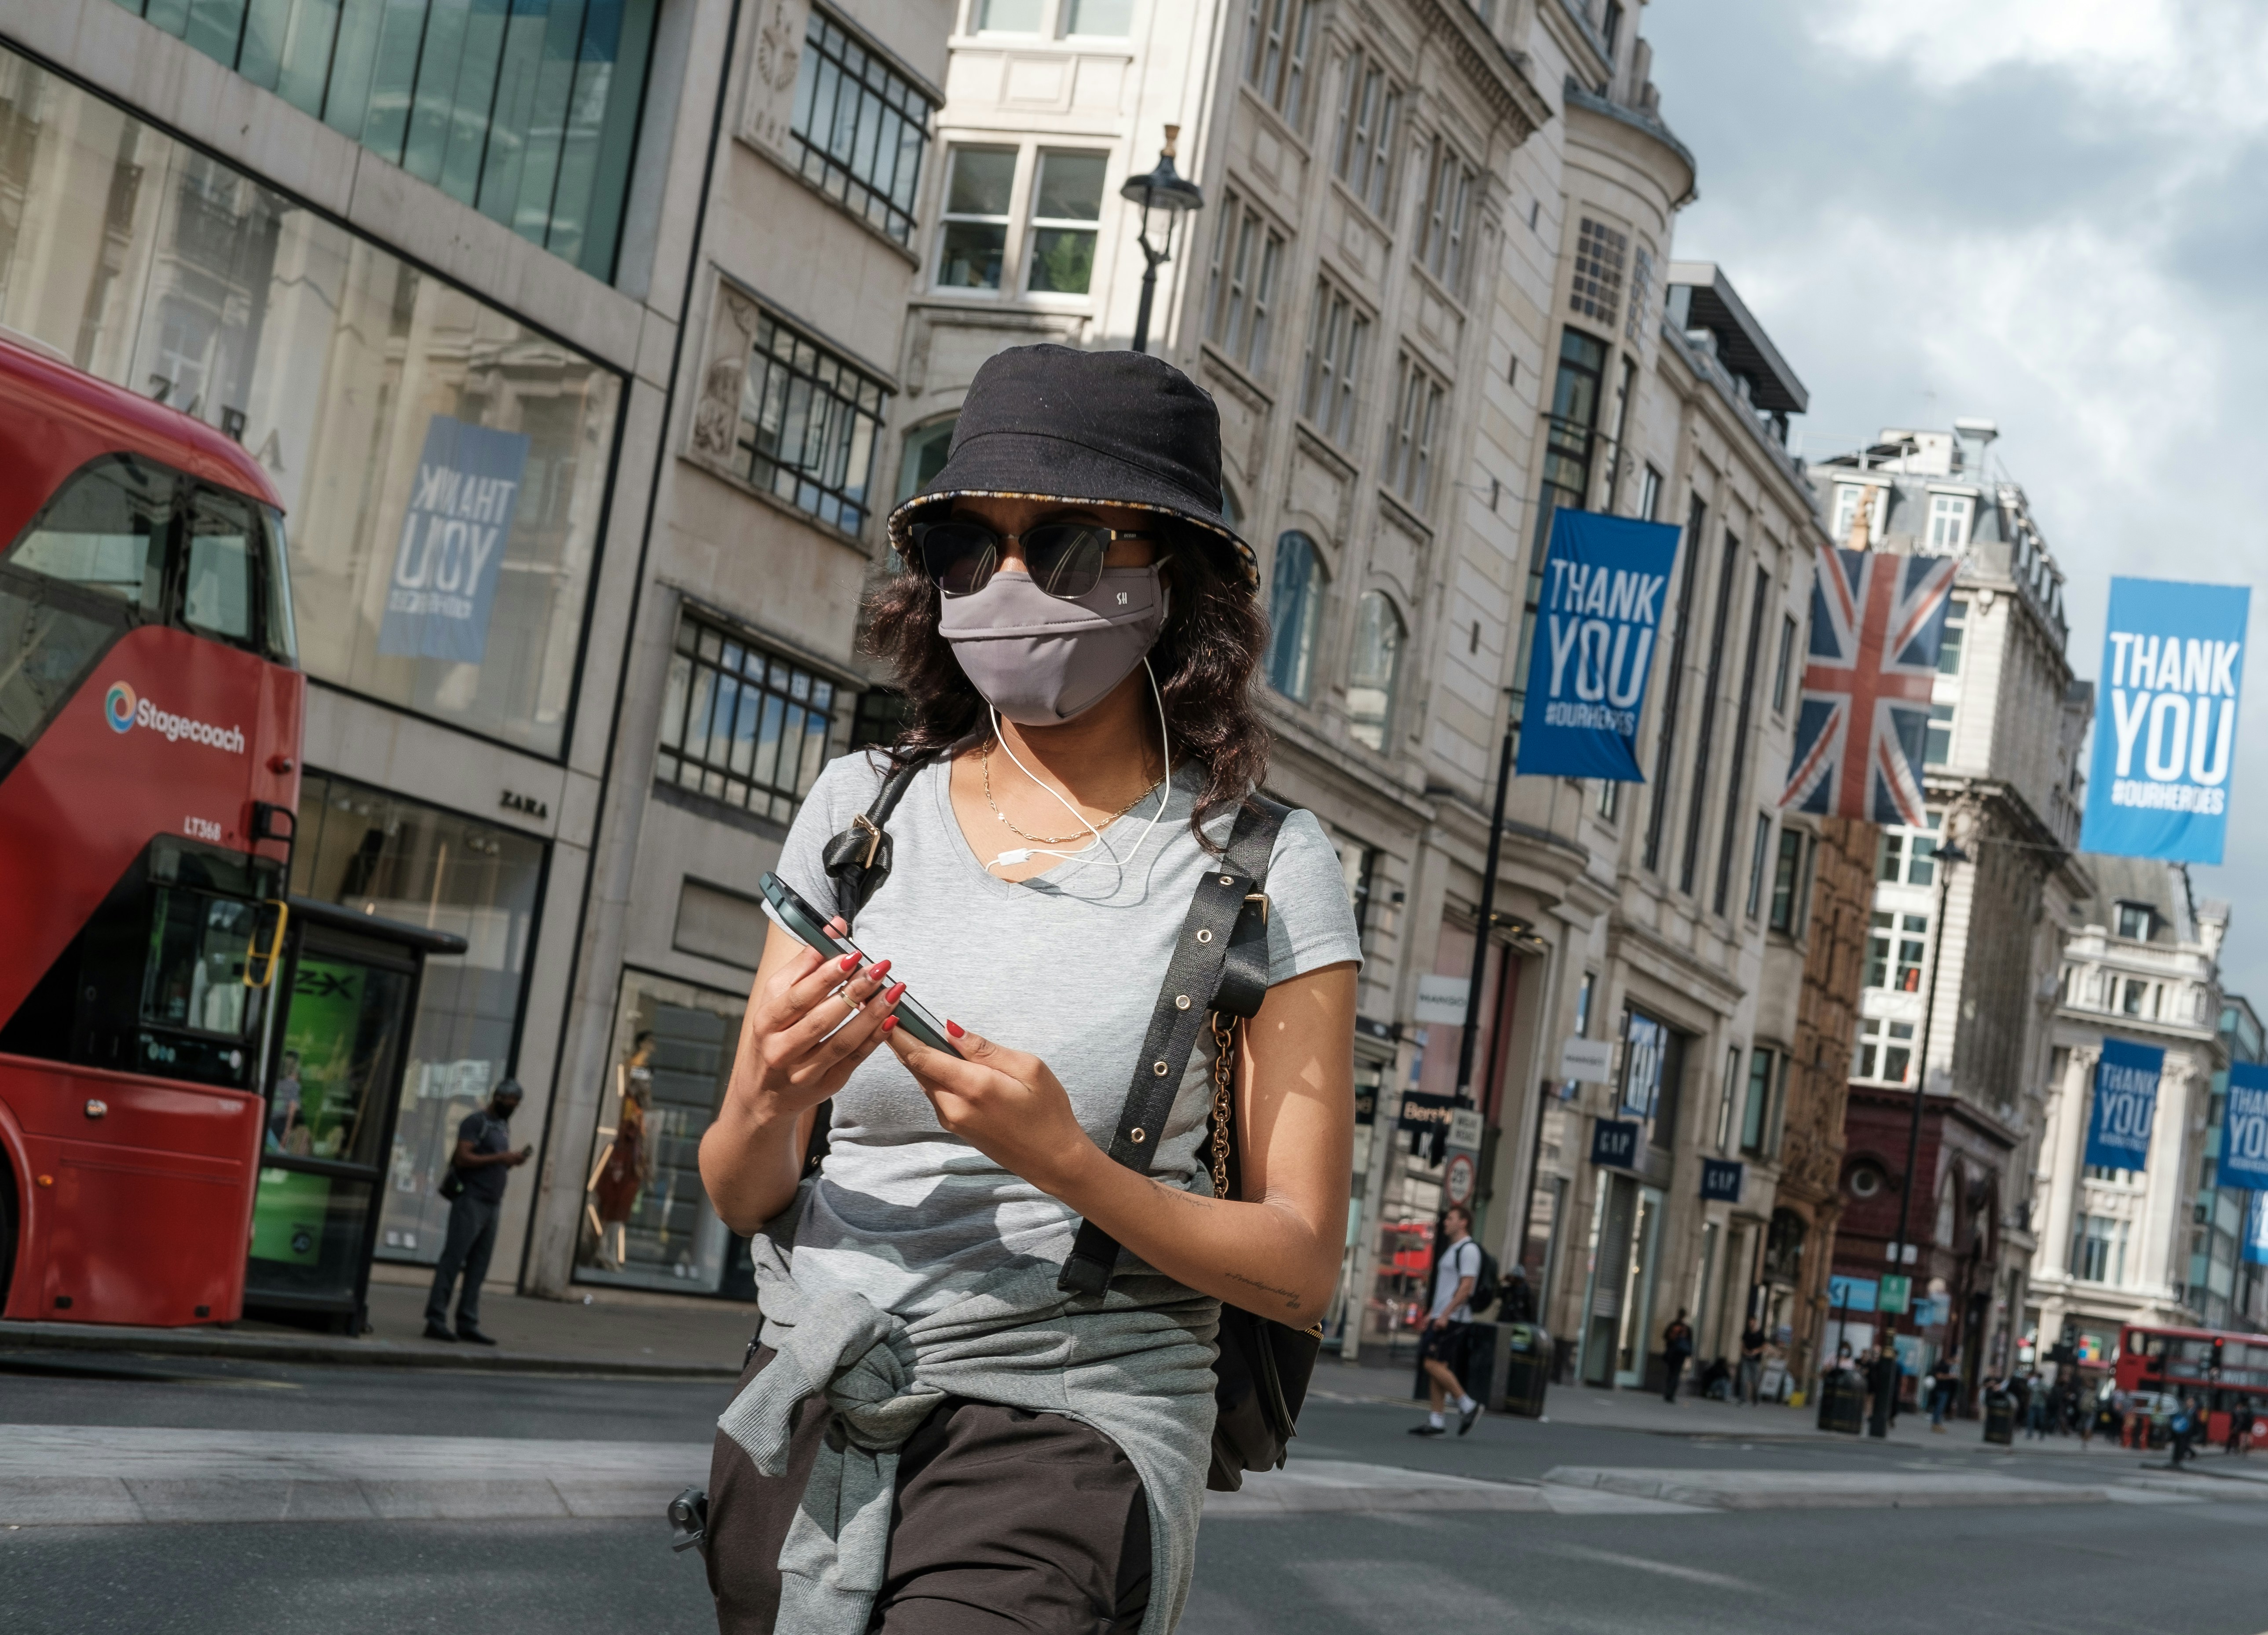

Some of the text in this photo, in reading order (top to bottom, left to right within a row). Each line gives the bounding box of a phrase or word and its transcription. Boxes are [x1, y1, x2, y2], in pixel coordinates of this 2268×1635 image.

[1550, 558, 1665, 625] THANK
[1549, 614, 1653, 708] YOU
[2109, 632, 2240, 697] THANK
[136, 697, 245, 754] Stagecoach
[2111, 688, 2235, 786] YOU
[500, 790, 548, 819] ZARA
[2101, 1090, 2155, 1138] YOU
[2230, 1112, 2268, 1159] YO
